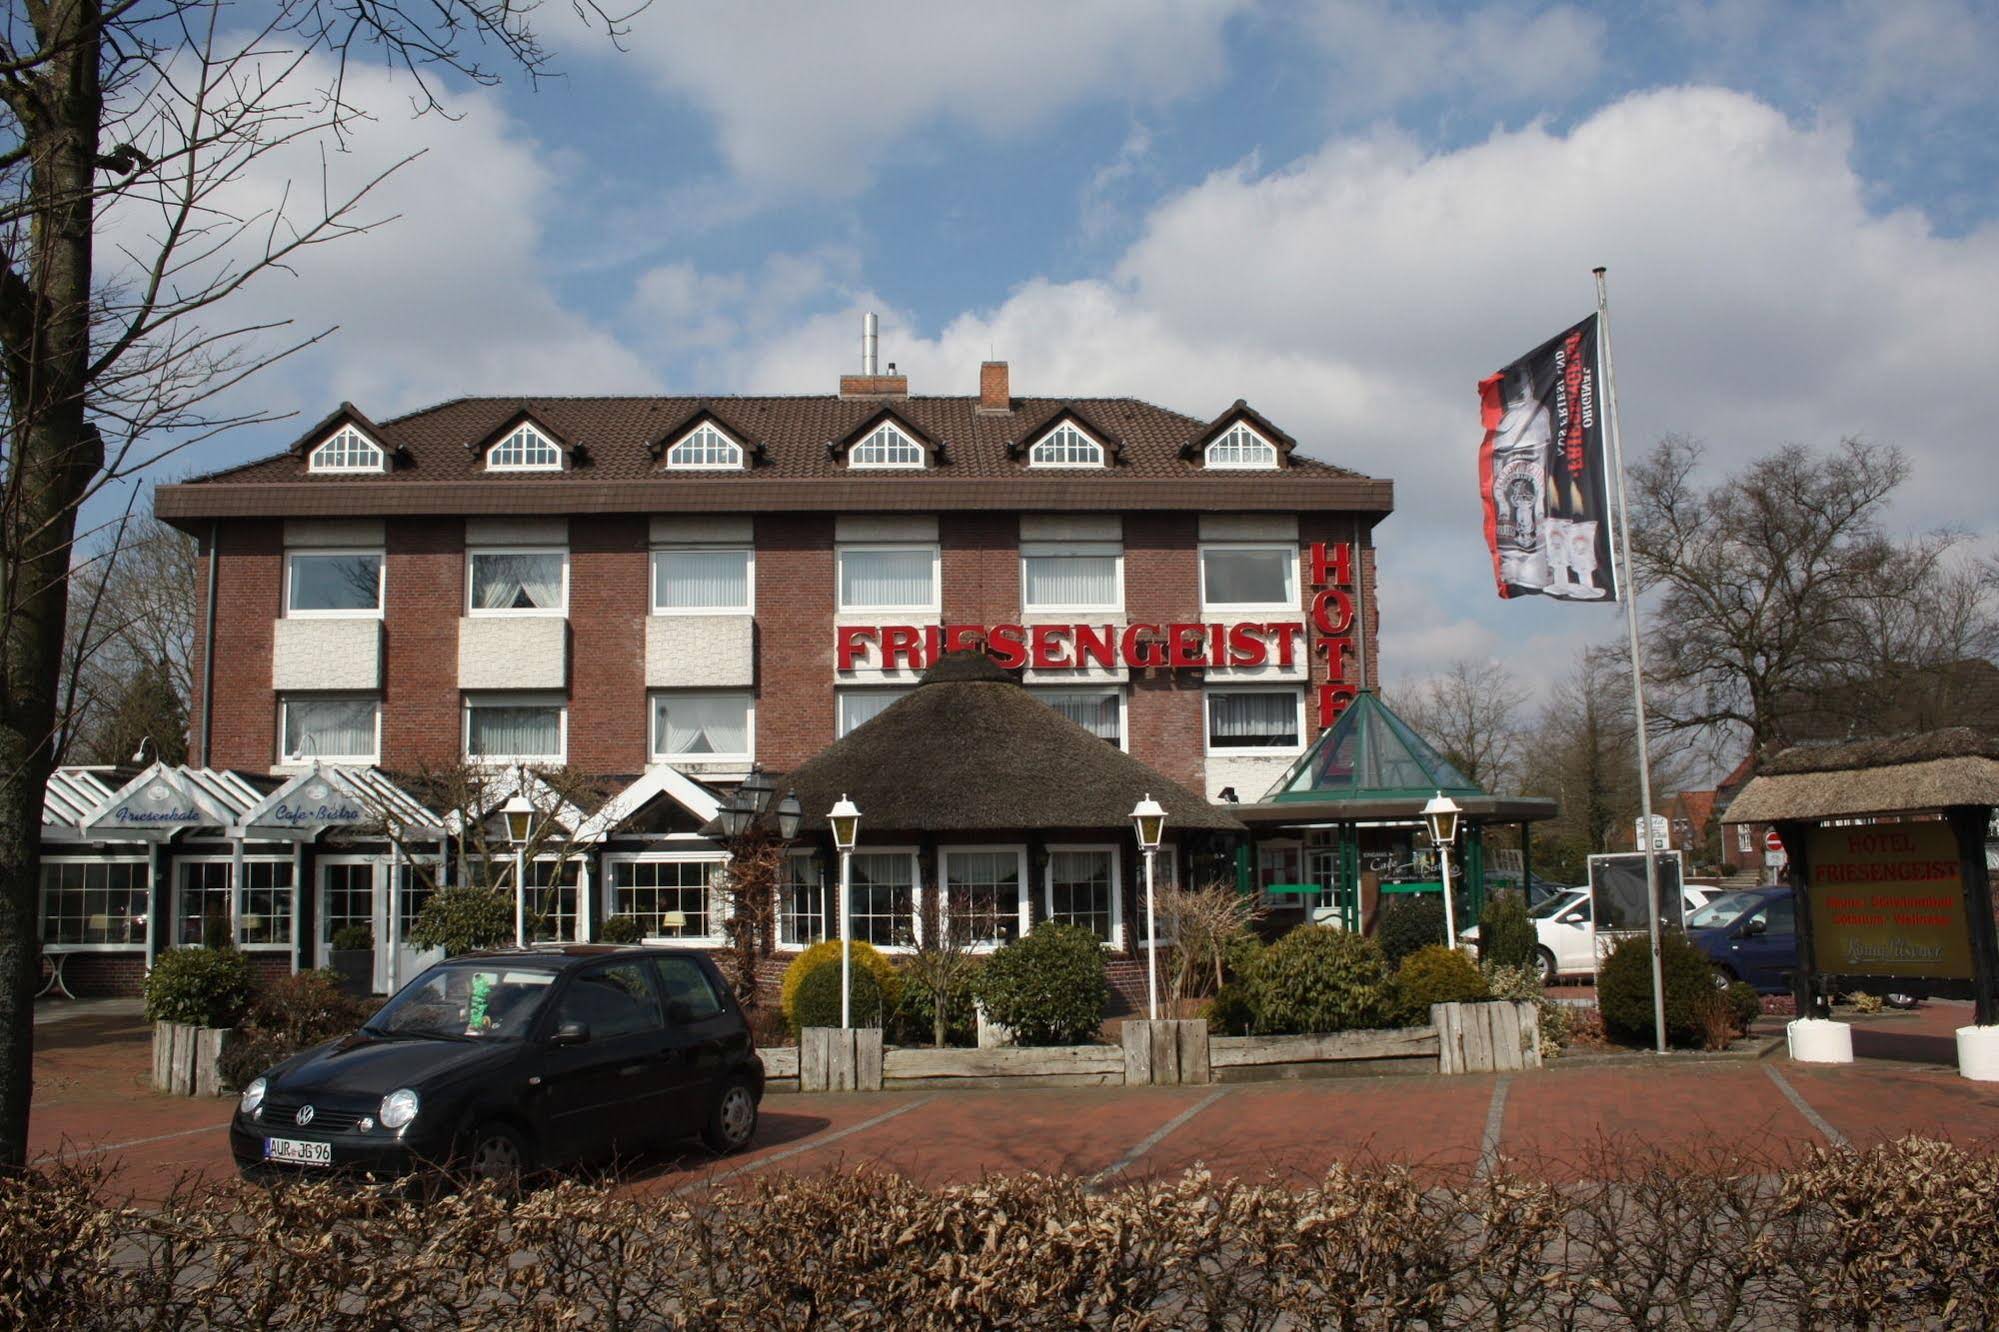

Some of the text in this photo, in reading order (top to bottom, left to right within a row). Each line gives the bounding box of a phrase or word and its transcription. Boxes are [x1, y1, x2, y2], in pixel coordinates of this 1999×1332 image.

[837, 622, 1304, 670] FRIESENGEIST
[316, 804, 359, 820] Bistro
[1848, 836, 1915, 853] HOTEL
[271, 1139, 330, 1160] AUR JG 96
